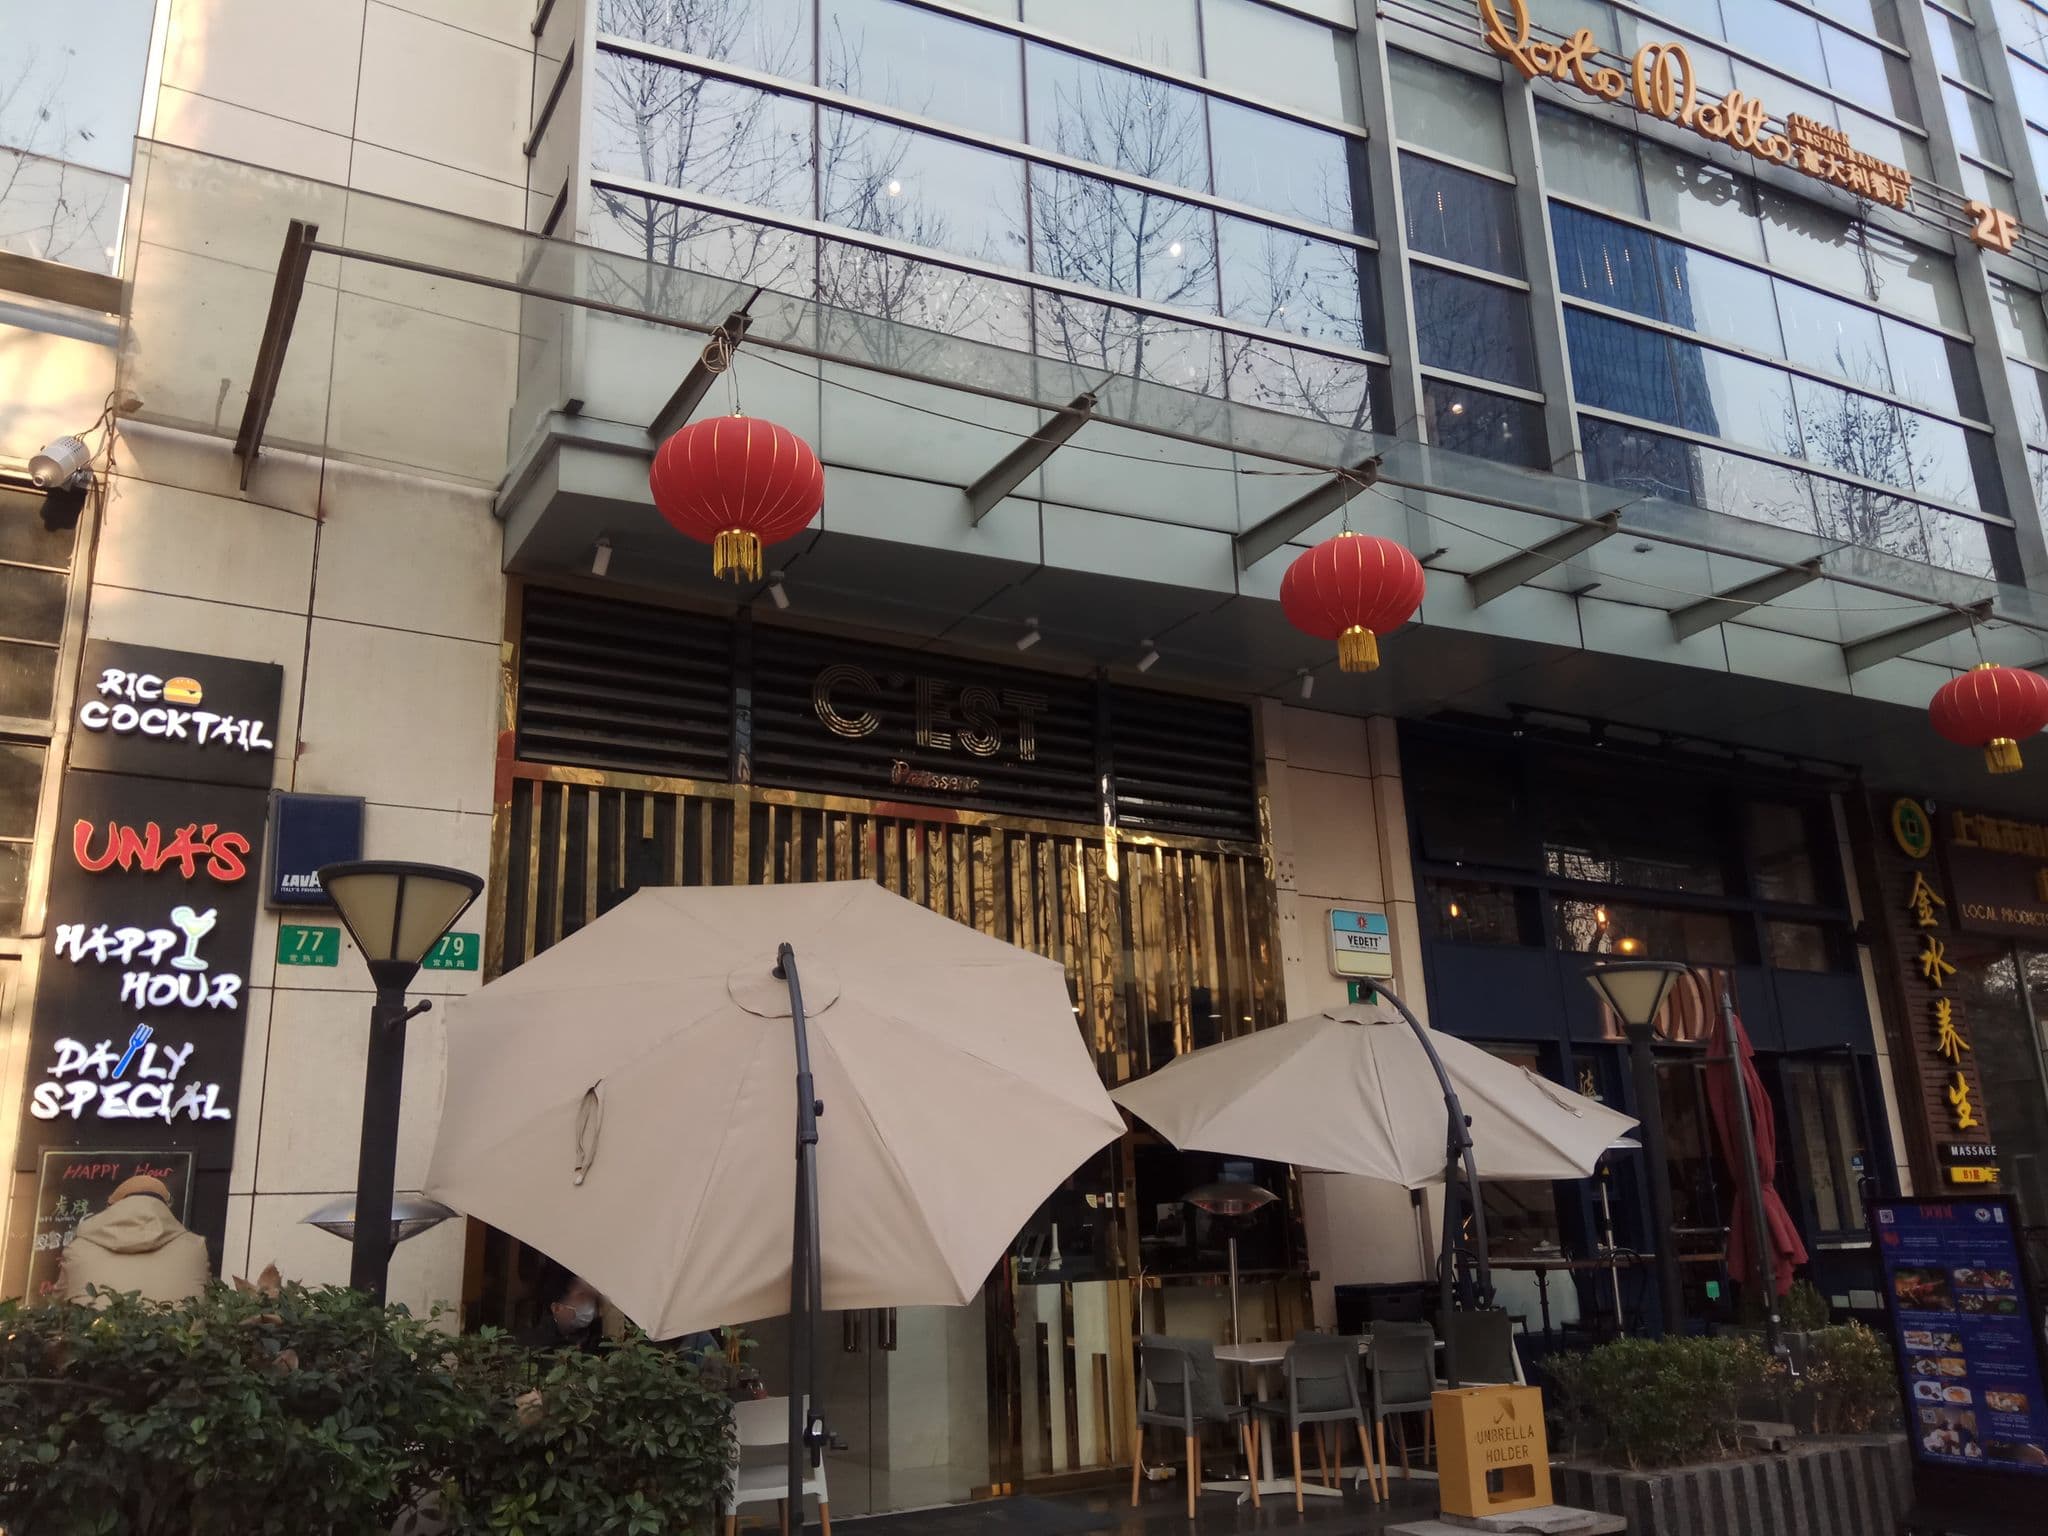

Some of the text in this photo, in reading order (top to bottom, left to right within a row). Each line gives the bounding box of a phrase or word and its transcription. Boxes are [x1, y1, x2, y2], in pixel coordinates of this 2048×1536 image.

[1632, 41, 1791, 165] Matto
[1790, 112, 1850, 145] ITALIAN
[1797, 144, 1909, 207] 意大利餐厅
[1965, 200, 2019, 251] 2F
[80, 701, 273, 750] COCKTAIL
[73, 819, 251, 880] UNA'S
[281, 870, 321, 887] LAVA
[1962, 903, 1998, 921] LOCAL
[297, 931, 324, 951] 77
[439, 937, 464, 956] 79
[1347, 935, 1379, 947] VEDETT
[120, 969, 242, 1009] HOUR
[30, 1081, 231, 1121] SPECIAL
[1951, 1145, 1998, 1157] MASSAGE
[63, 1163, 120, 1180] HAPPY
[1476, 1425, 1535, 1444] UMBRELLA
[1486, 1445, 1529, 1463] HOLDER
